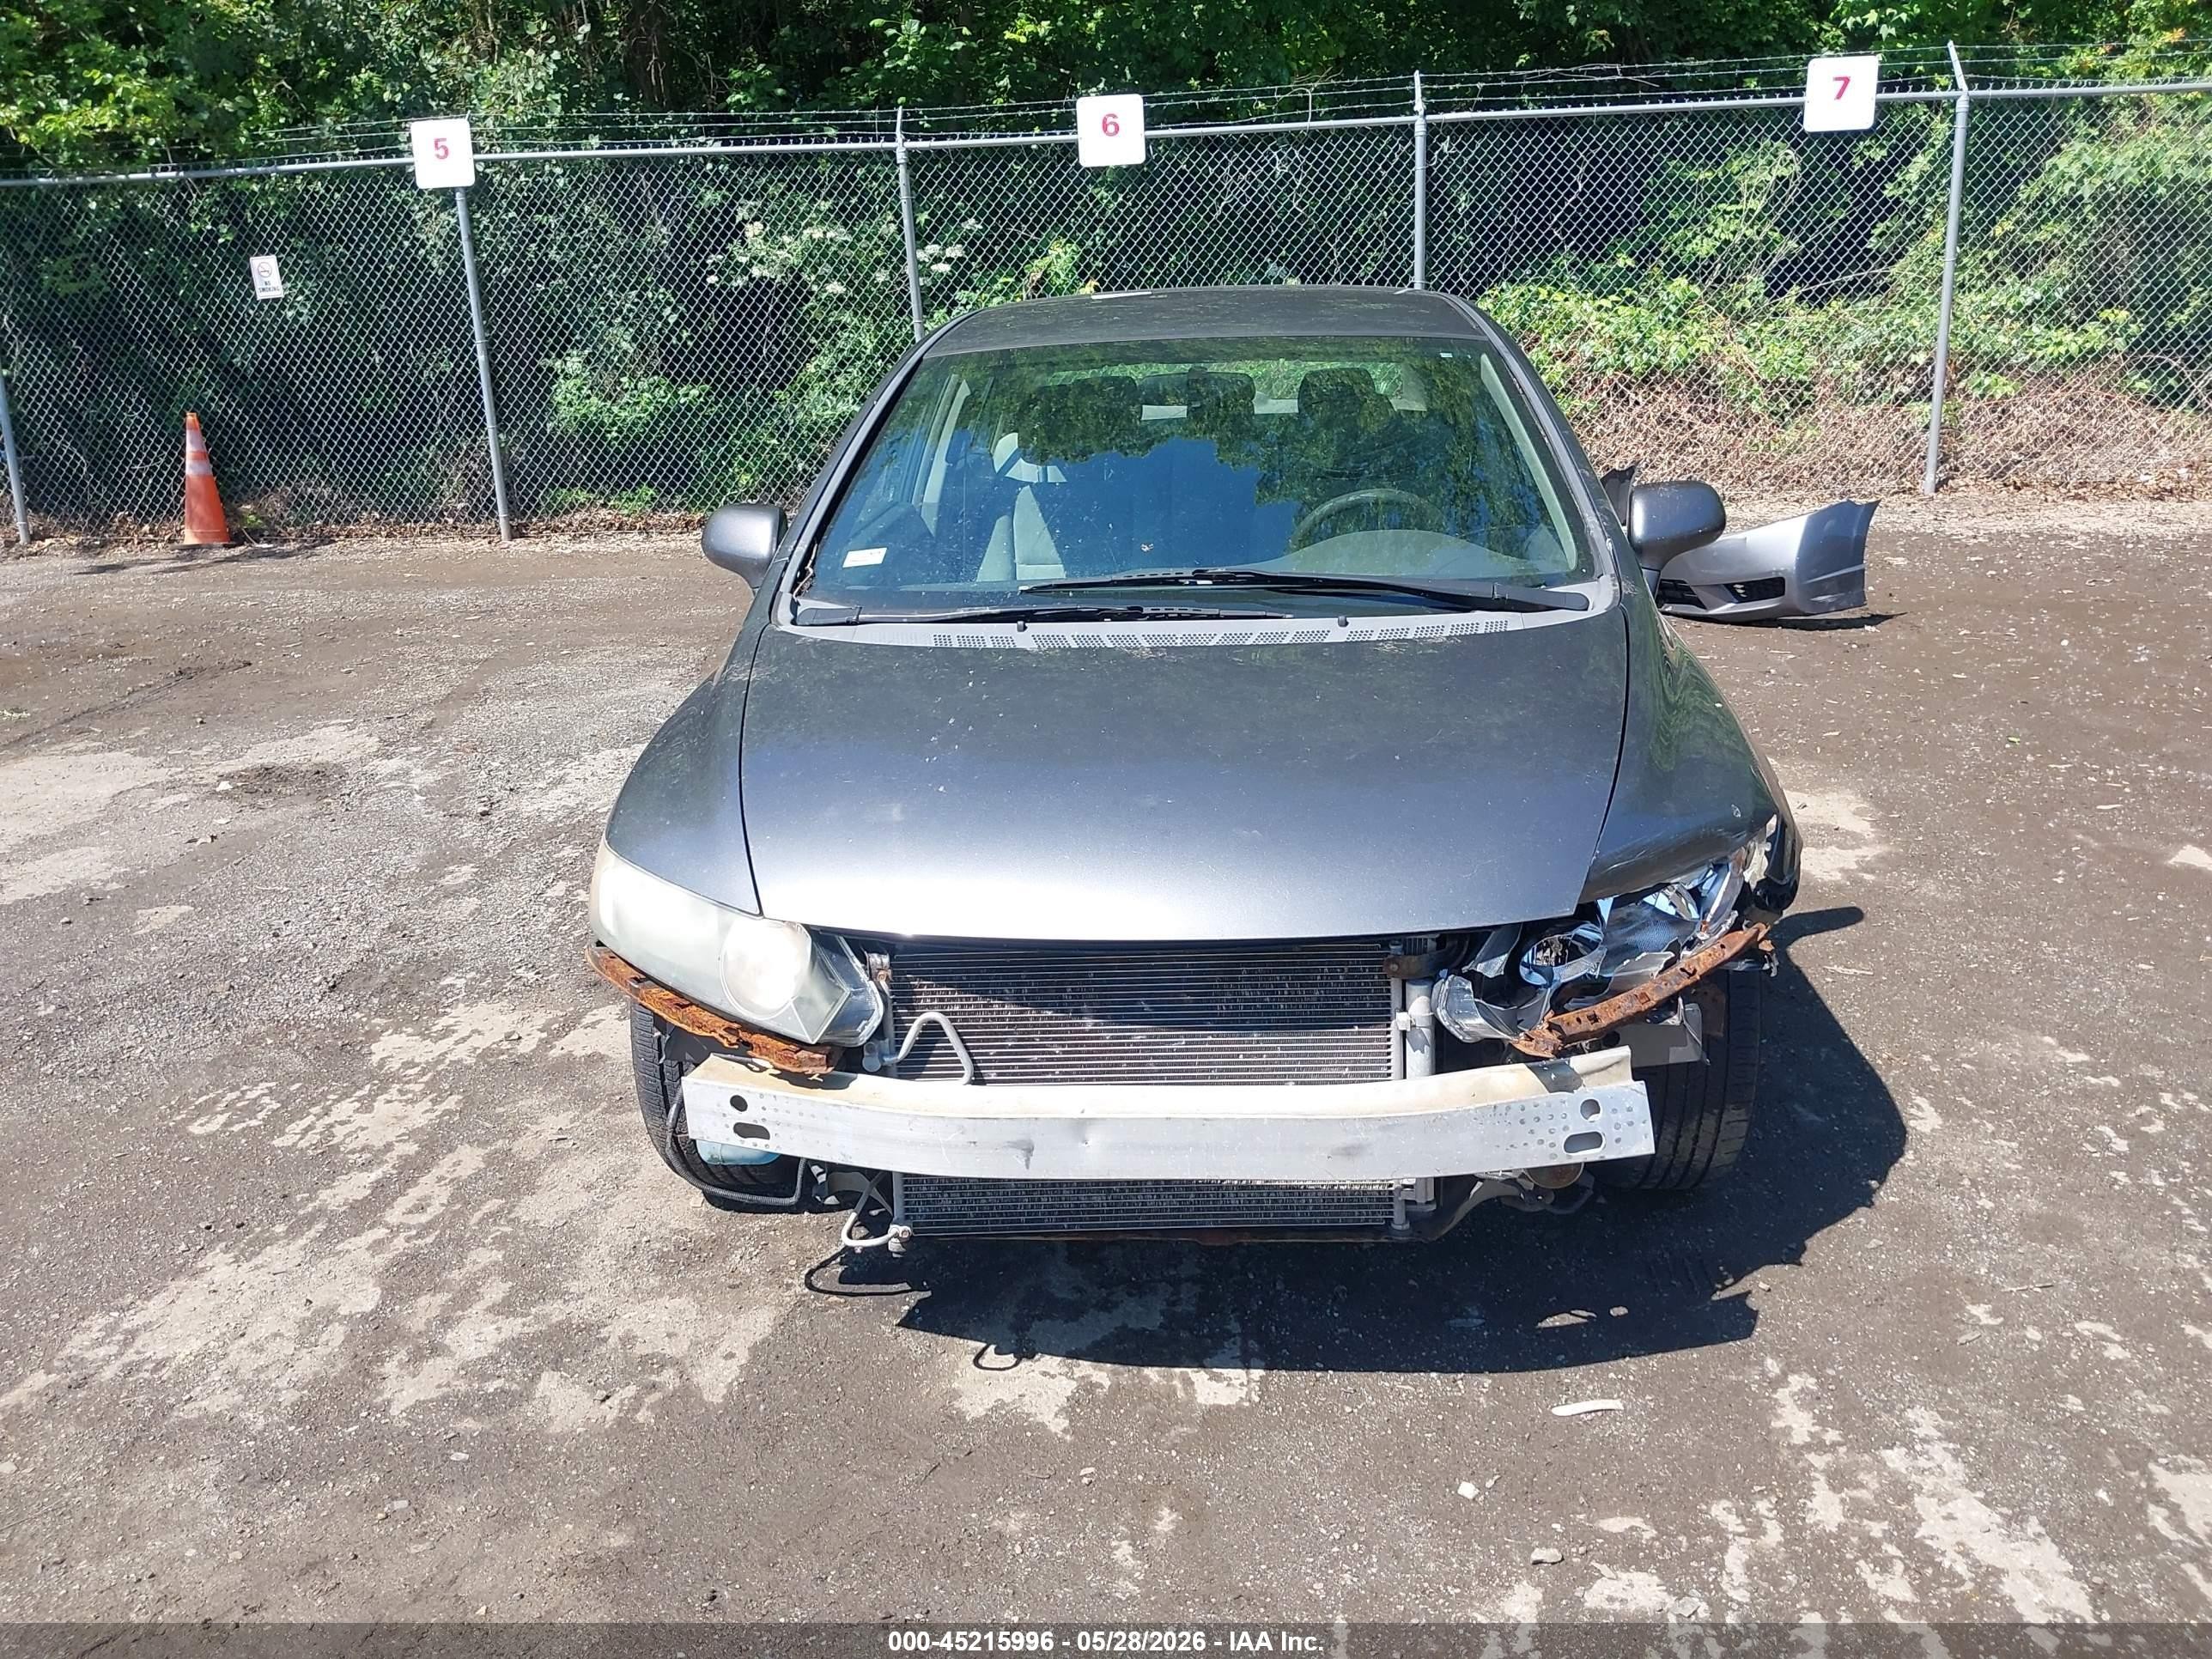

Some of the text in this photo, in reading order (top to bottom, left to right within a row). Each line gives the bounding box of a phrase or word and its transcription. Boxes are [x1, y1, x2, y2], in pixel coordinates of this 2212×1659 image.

[1833, 76, 1850, 100] 7
[1102, 112, 1120, 137] 6
[434, 137, 449, 160] 5
